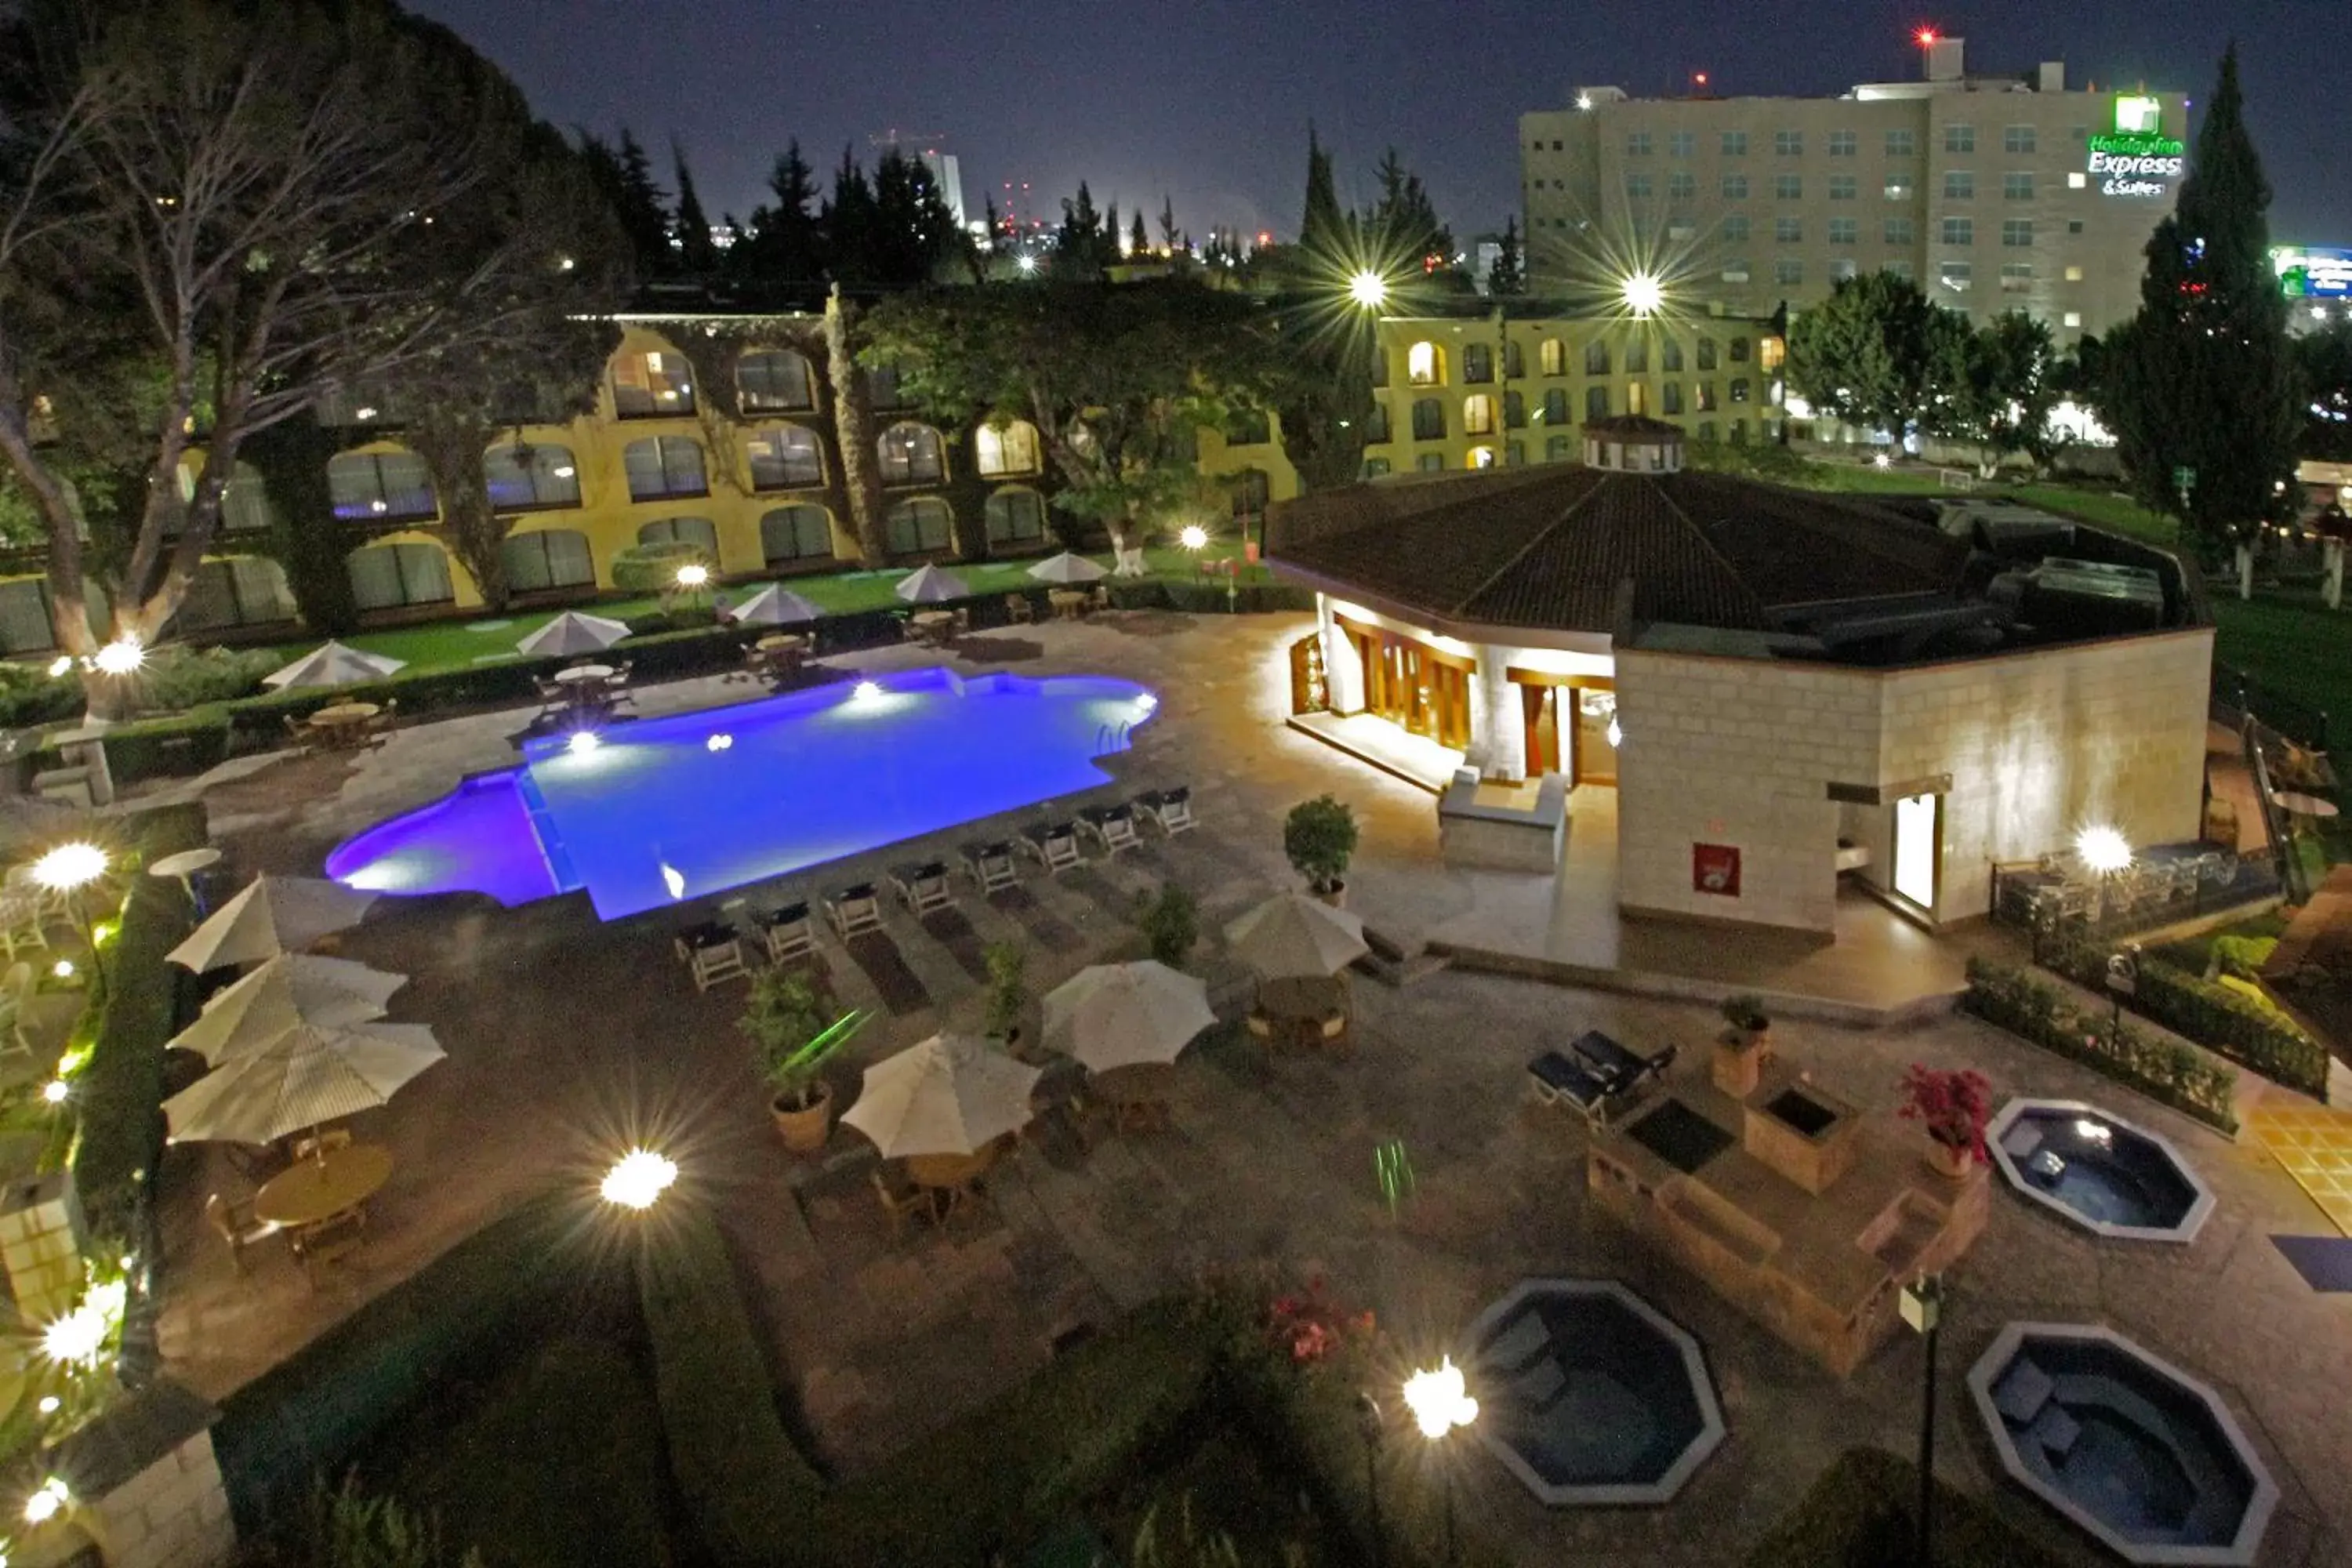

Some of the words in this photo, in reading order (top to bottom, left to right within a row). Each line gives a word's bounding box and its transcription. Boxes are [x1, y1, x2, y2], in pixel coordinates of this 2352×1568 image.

[2089, 136, 2154, 156] Holiday
[2154, 137, 2183, 154] Inn
[2088, 151, 2183, 180] Express
[2103, 179, 2116, 195] &
[2116, 180, 2165, 196] Suites
